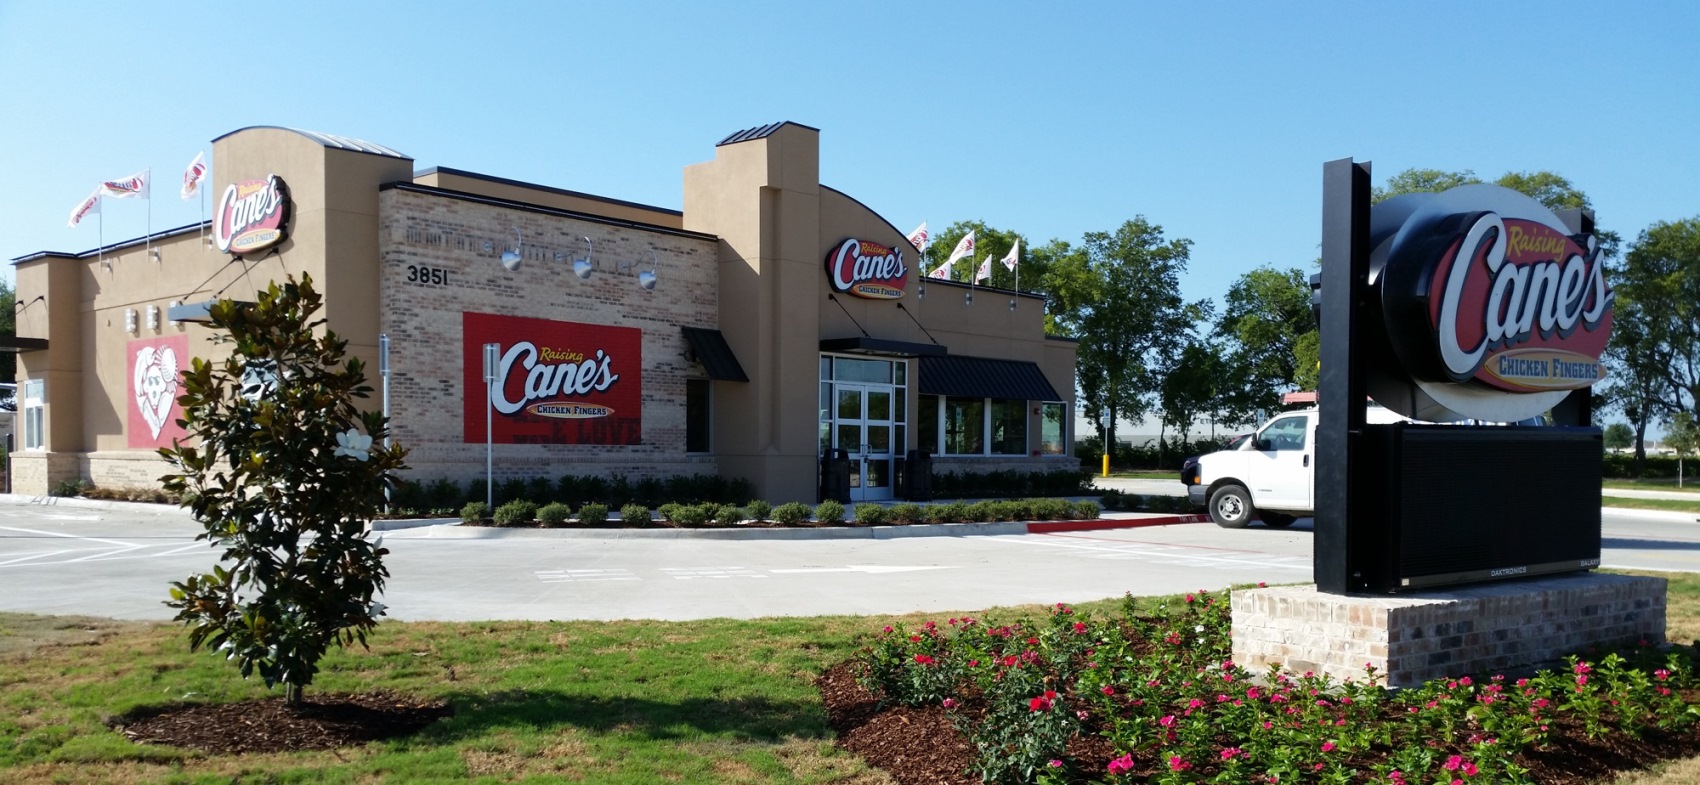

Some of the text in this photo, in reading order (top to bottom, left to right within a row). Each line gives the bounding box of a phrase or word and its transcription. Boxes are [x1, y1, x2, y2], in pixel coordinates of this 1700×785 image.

[216, 173, 281, 250] Cane's
[861, 242, 887, 257] Raising
[1507, 226, 1566, 263] Raising
[407, 265, 448, 286] 3851
[834, 238, 907, 291] Cane's
[859, 285, 902, 297] CHICKEN FINGERS
[1439, 212, 1615, 374] Cane's
[540, 347, 584, 365] Raising
[1499, 355, 1599, 380] CHICKEN FINGERS
[491, 341, 619, 414] Cane's
[537, 404, 607, 416] CHICKEN FINGERS
[1491, 566, 1527, 577] DAKTRONICS
